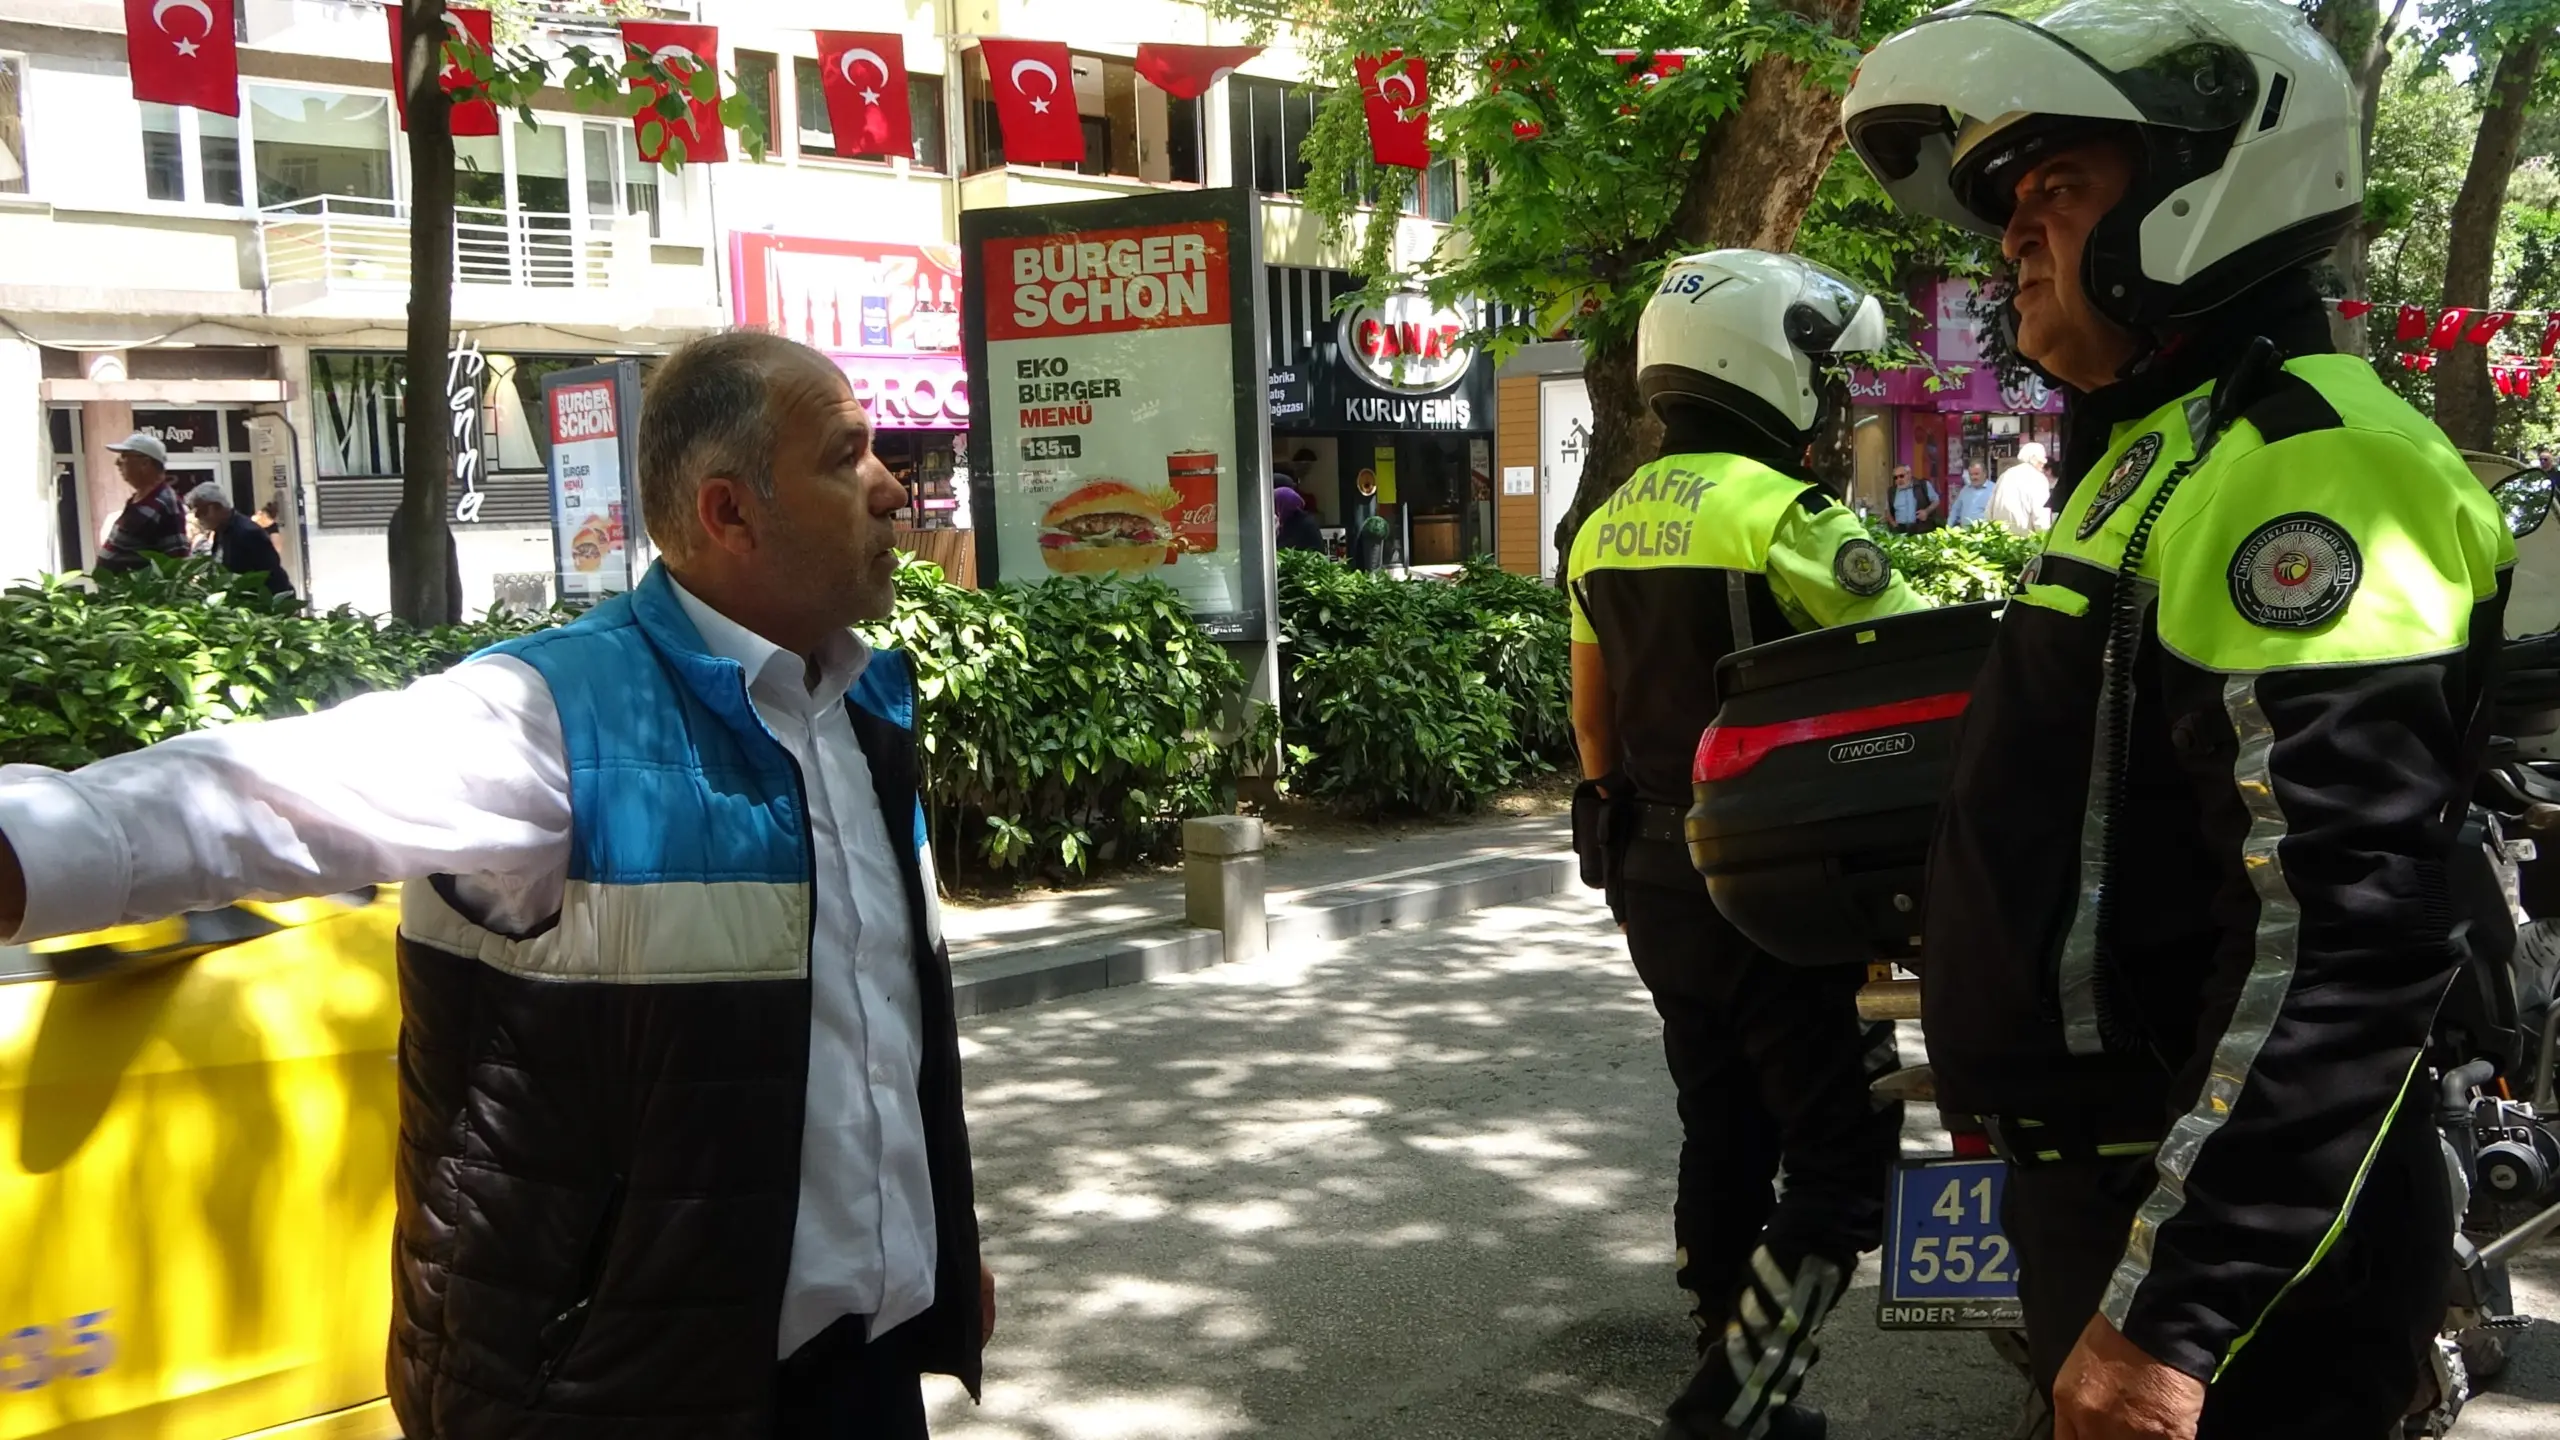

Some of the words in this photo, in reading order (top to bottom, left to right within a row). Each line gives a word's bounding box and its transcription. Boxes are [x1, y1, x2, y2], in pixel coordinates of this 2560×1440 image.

[1013, 234, 1207, 285] BURGER
[1013, 271, 1208, 328] SCHON
[1017, 357, 1069, 379] EKO
[1268, 371, 1296, 384] abrika
[557, 388, 611, 415] BURGER
[1018, 379, 1121, 403] BURGER
[1269, 389, 1286, 401] atış
[559, 408, 615, 438] SCHON
[1020, 400, 1093, 428] MENÜ
[1268, 402, 1304, 417] ağazası
[1345, 393, 1471, 430] KURUYEMİŞ
[447, 330, 485, 522] Henna
[1932, 1177, 1992, 1225] 41
[1909, 1235, 2020, 1284] 552
[1882, 1307, 1956, 1323] ENDER
